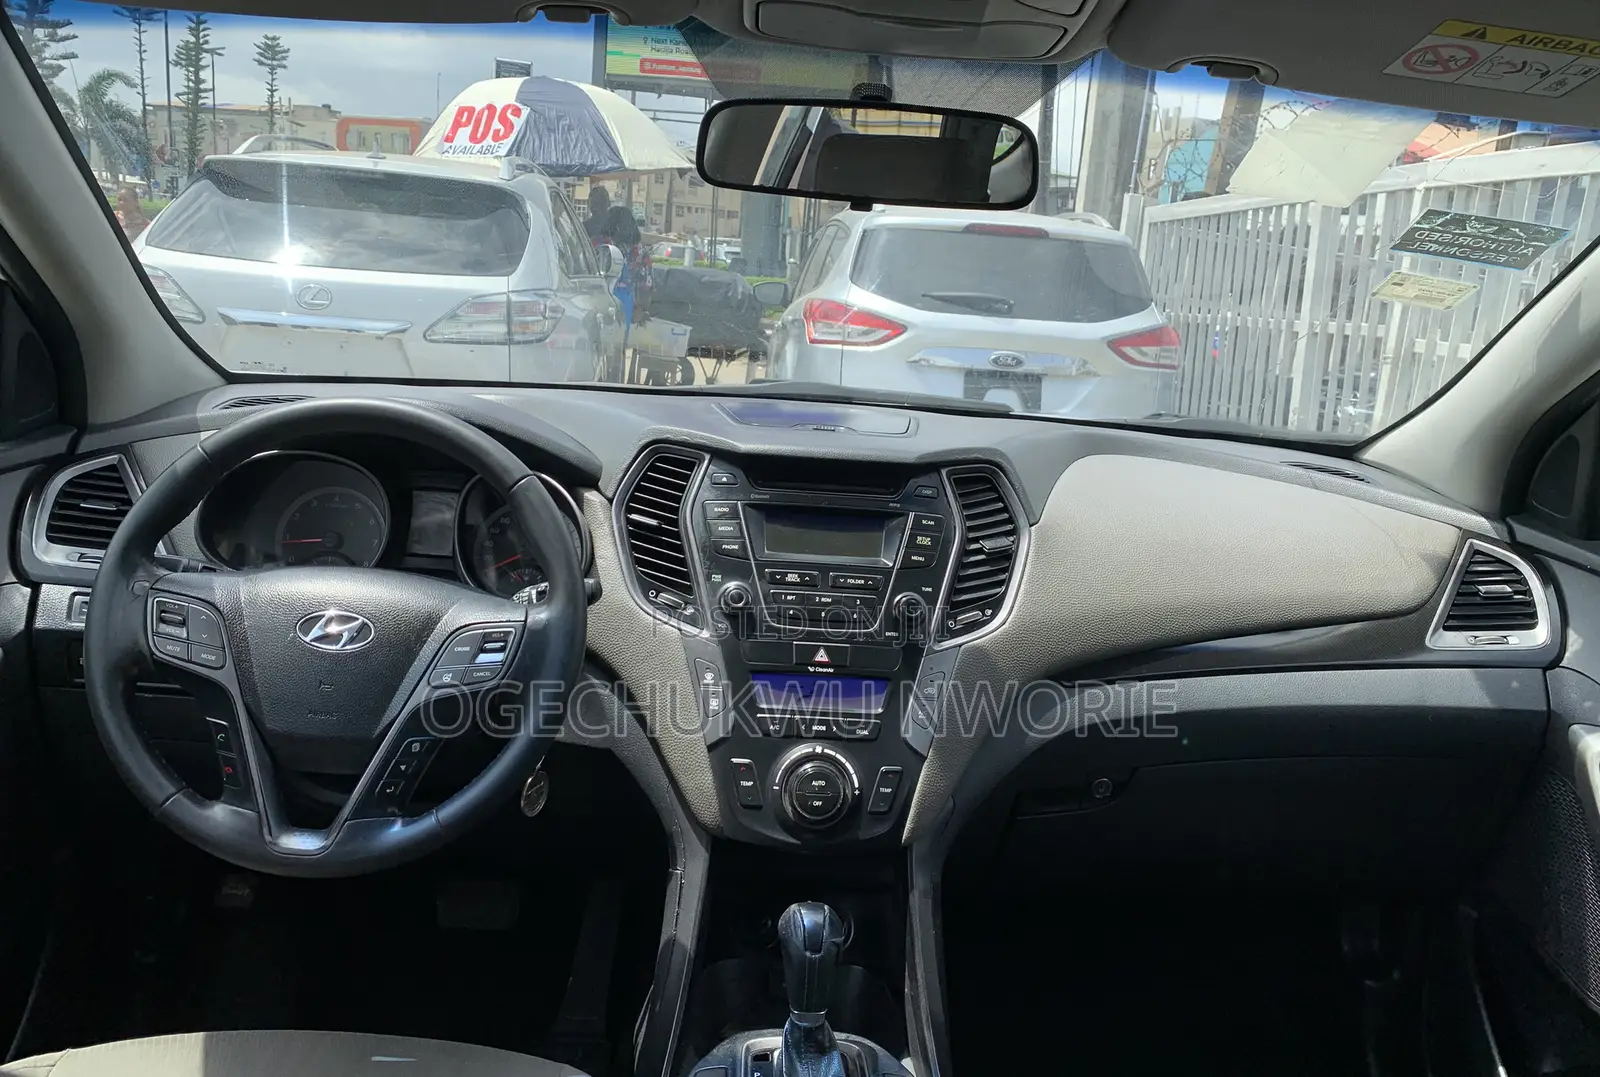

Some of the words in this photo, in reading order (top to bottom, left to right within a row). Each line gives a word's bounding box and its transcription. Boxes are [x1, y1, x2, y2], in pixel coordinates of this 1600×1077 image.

[443, 103, 522, 144] POS
[442, 143, 504, 155] AVAILABLE
[201, 653, 217, 661] MODE
